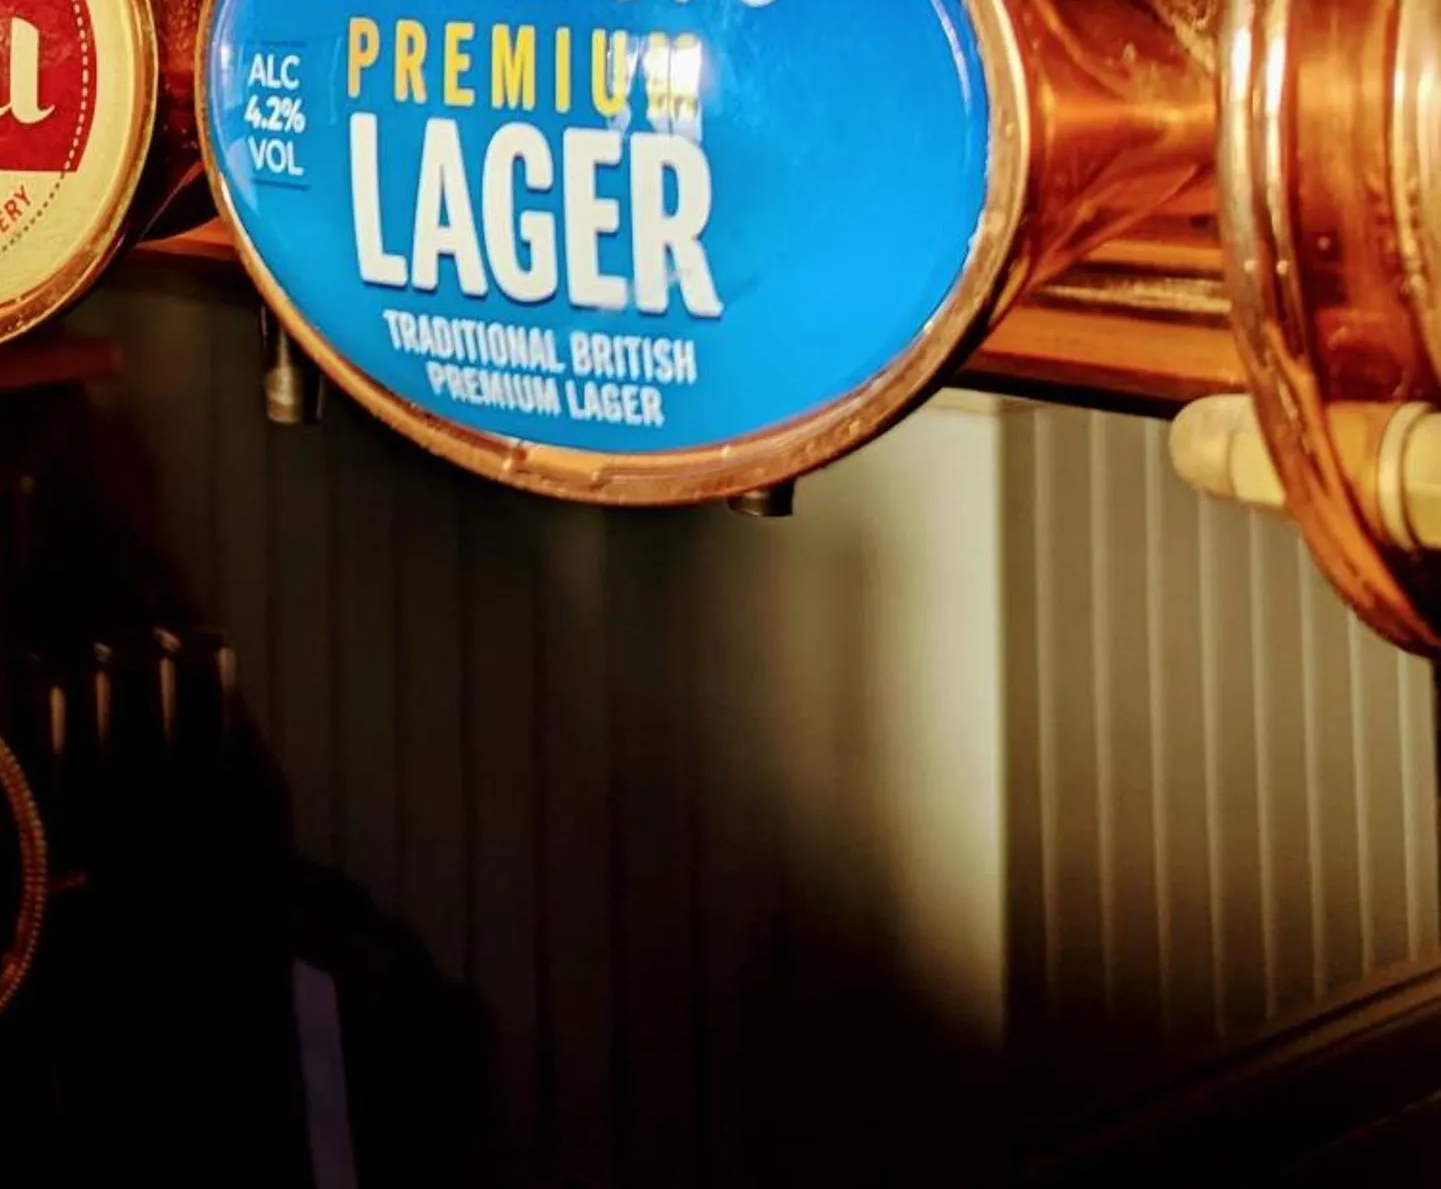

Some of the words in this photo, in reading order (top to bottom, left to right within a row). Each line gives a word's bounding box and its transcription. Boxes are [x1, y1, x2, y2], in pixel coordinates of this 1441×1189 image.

[247, 53, 301, 90] ALC
[244, 94, 306, 133] 4.2%
[247, 136, 305, 176] VOL
[349, 113, 723, 317] LAGER
[383, 308, 566, 374] TRADITIONAL
[570, 331, 697, 385] BRITISH
[426, 361, 561, 417] PREMIUM
[565, 379, 665, 428] LAGER
